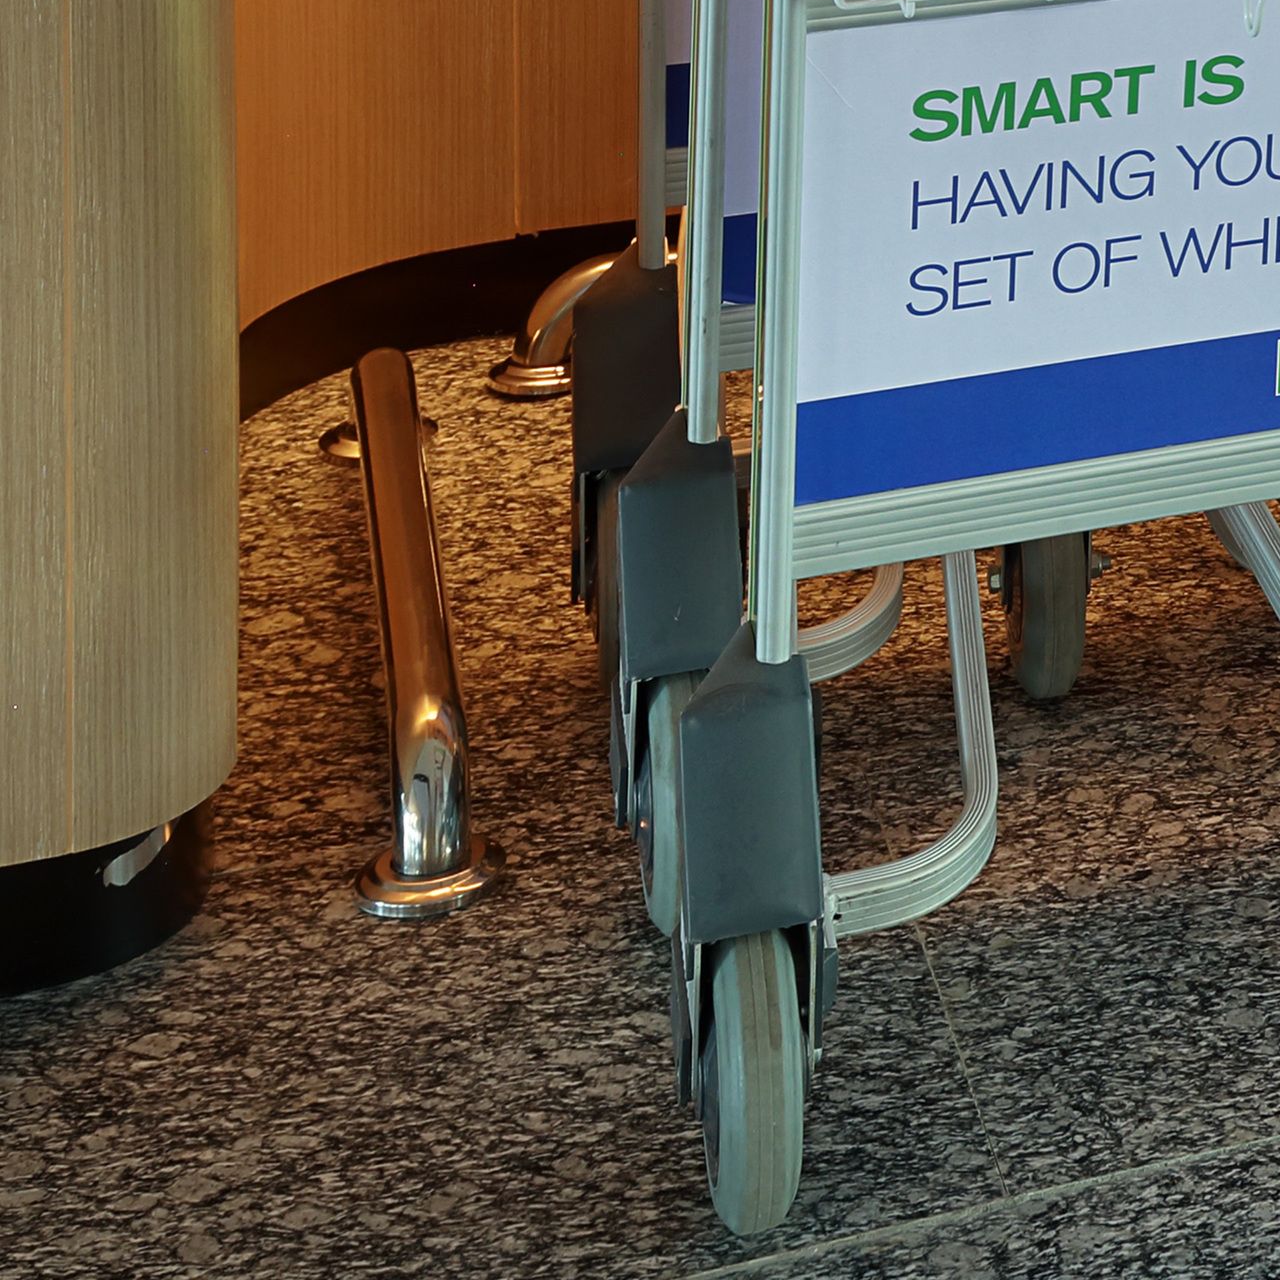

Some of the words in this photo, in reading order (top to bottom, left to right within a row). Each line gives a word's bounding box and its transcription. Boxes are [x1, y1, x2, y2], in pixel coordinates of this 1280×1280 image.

[909, 64, 1155, 142] SMART
[1183, 55, 1245, 108] IS
[911, 150, 1155, 230] HAVING
[906, 250, 1034, 316] SET
[1052, 235, 1142, 293] OF
